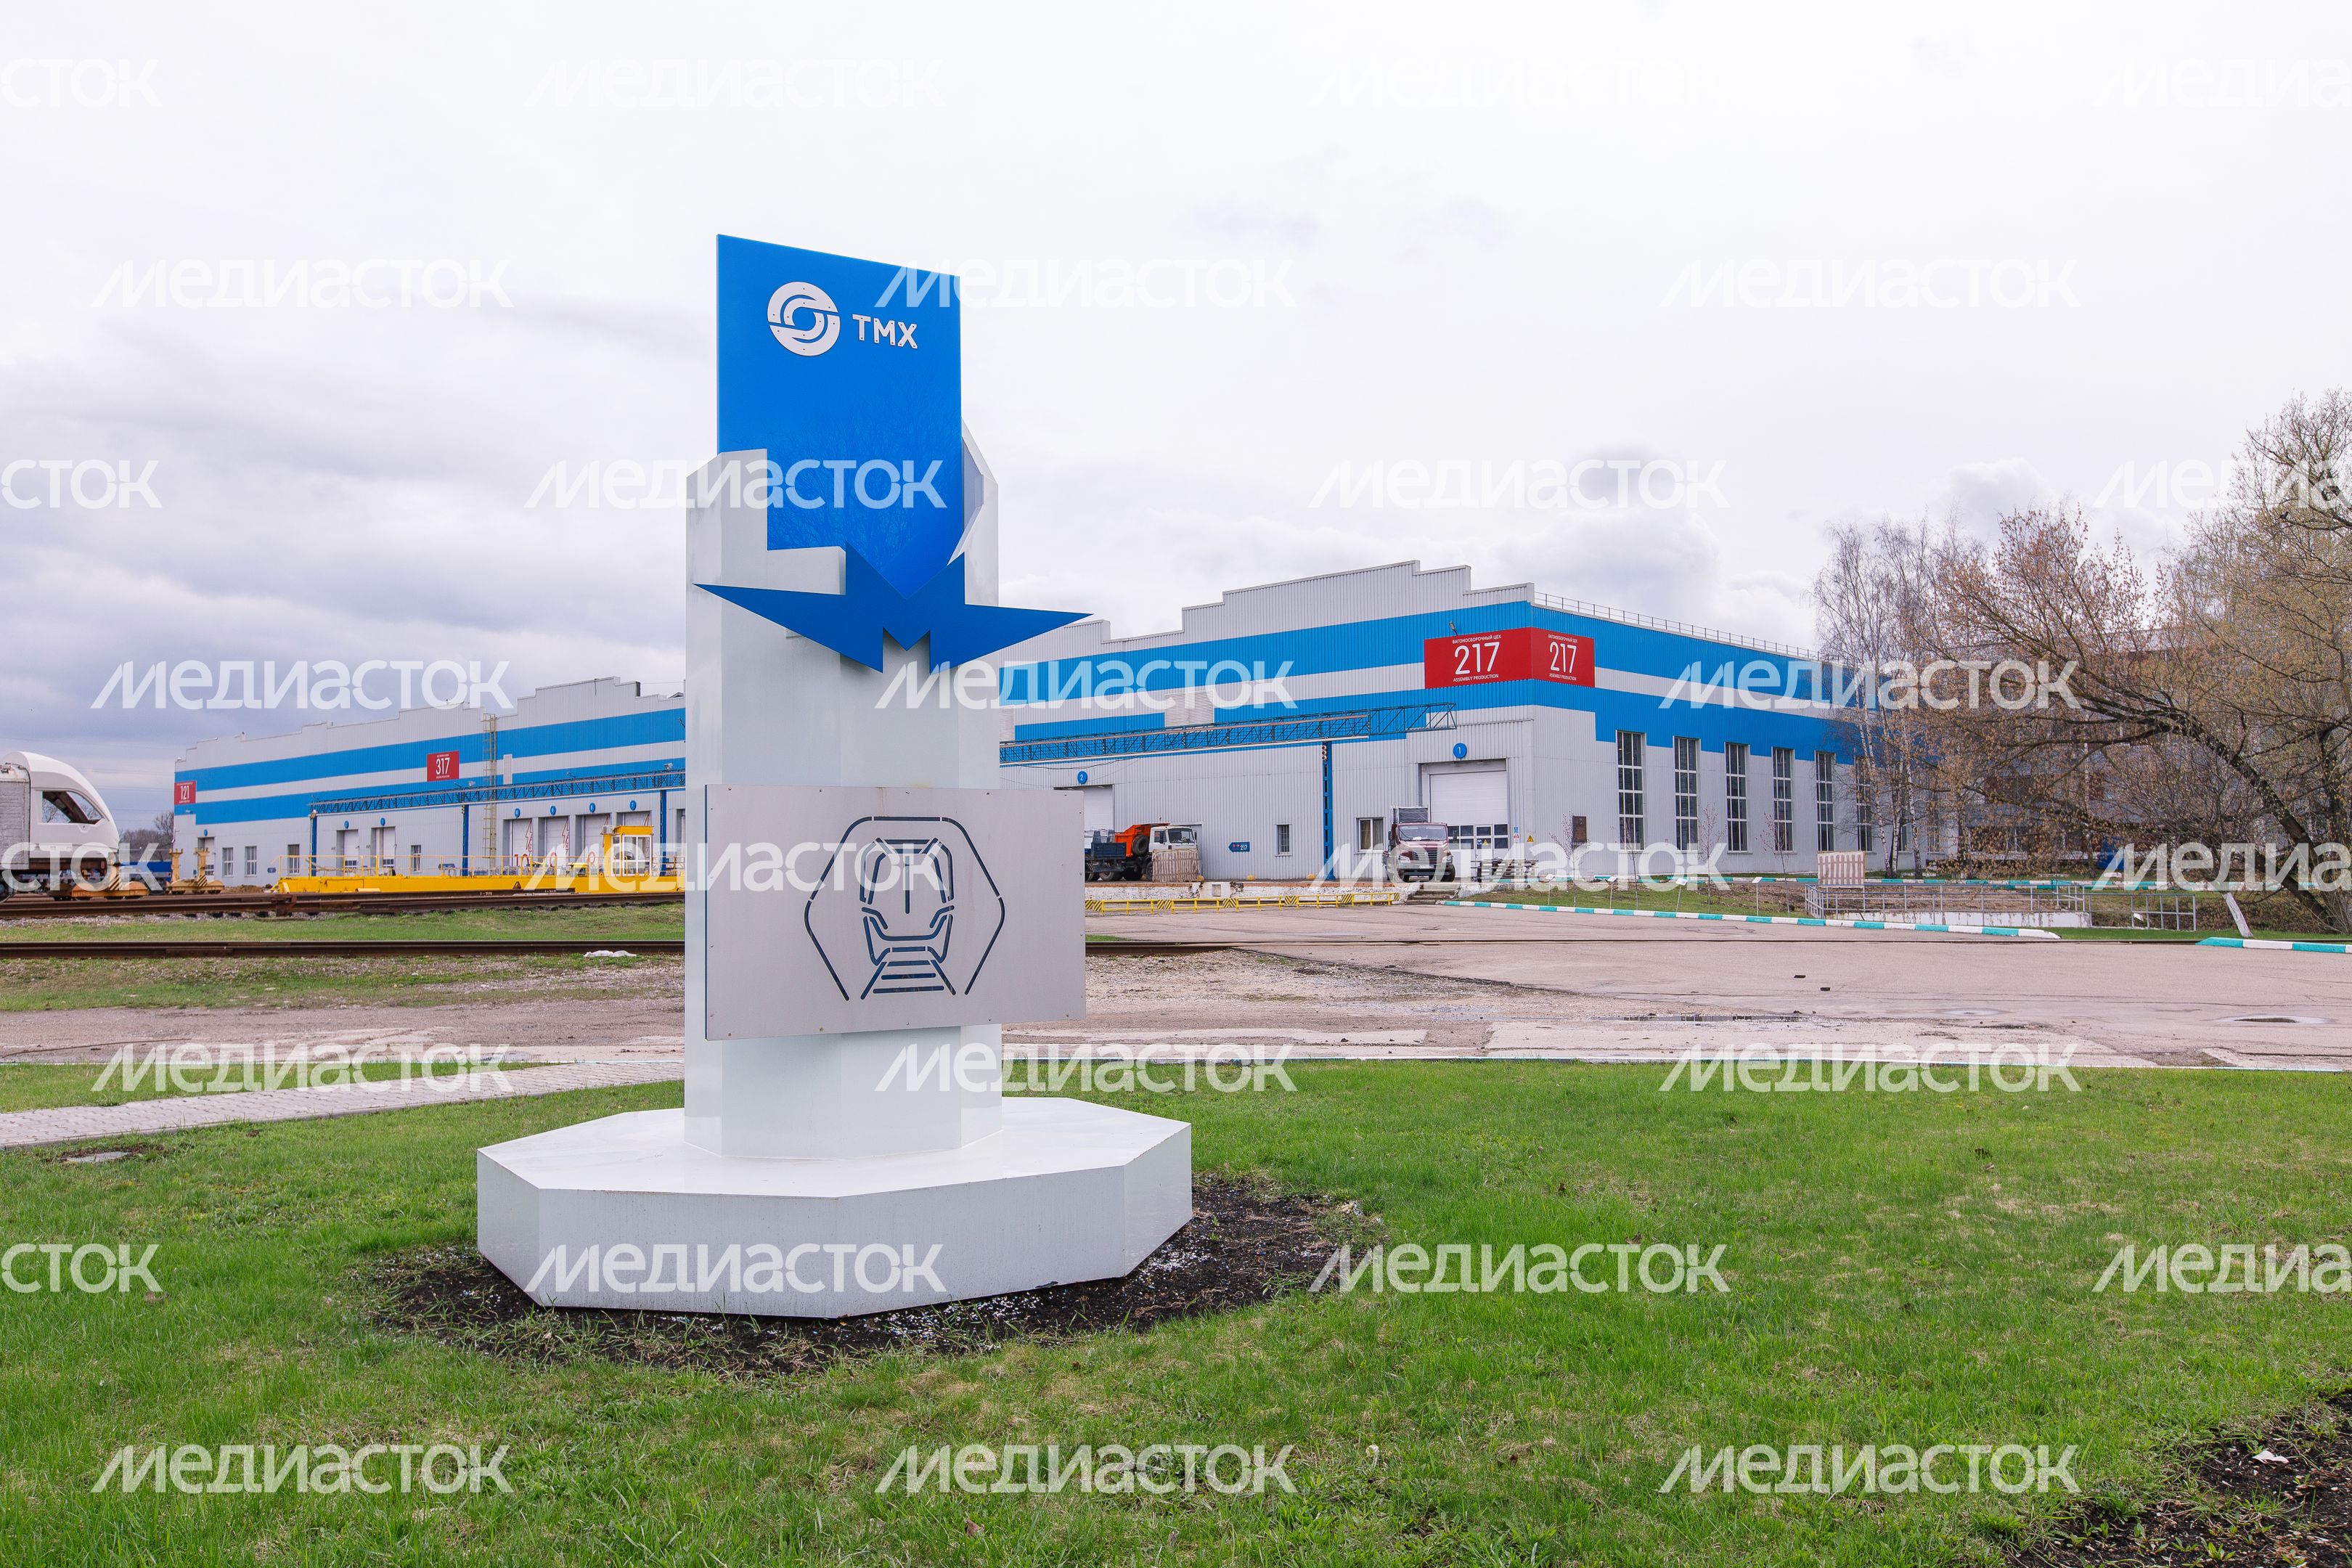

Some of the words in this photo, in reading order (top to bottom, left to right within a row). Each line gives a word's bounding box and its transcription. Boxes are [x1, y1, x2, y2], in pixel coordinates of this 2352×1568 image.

[1452, 635, 1493, 644] ВАГОНОСБОРОЧНЫЙ
[1454, 641, 1500, 675] 217
[1550, 641, 1577, 674] 217
[436, 757, 450, 775] 317
